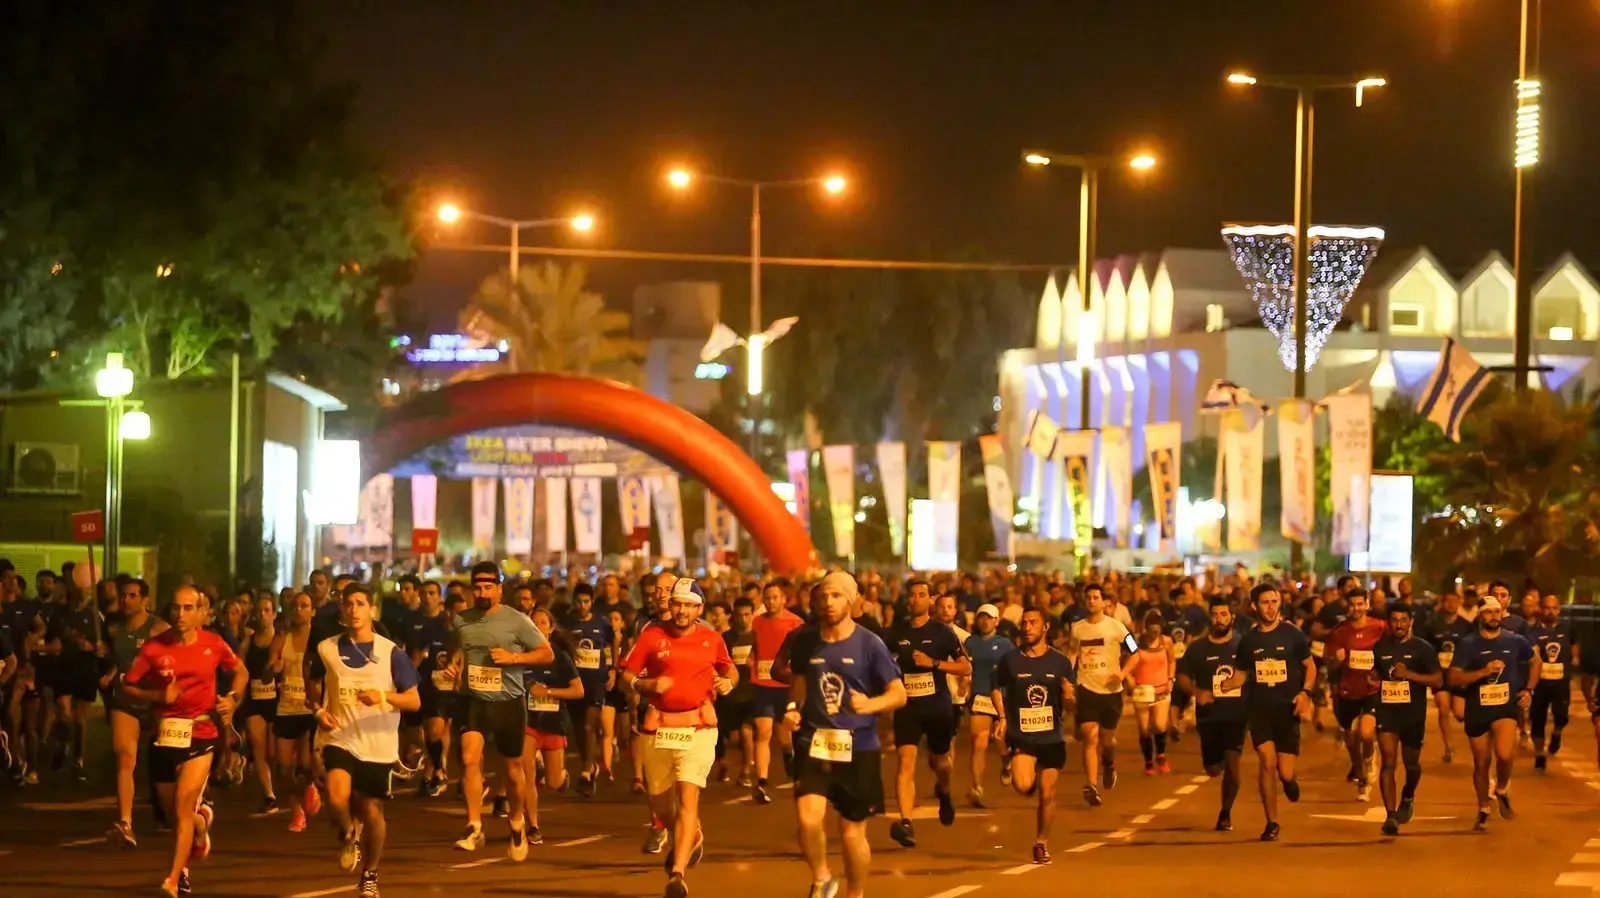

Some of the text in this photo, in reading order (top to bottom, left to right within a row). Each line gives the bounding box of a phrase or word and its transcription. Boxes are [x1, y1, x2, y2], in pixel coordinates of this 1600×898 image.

[466, 434, 504, 450] IKEA
[475, 675, 493, 684] 1021
[911, 682, 927, 690] 1639
[1029, 716, 1046, 725] 1029
[664, 732, 685, 741] 1672
